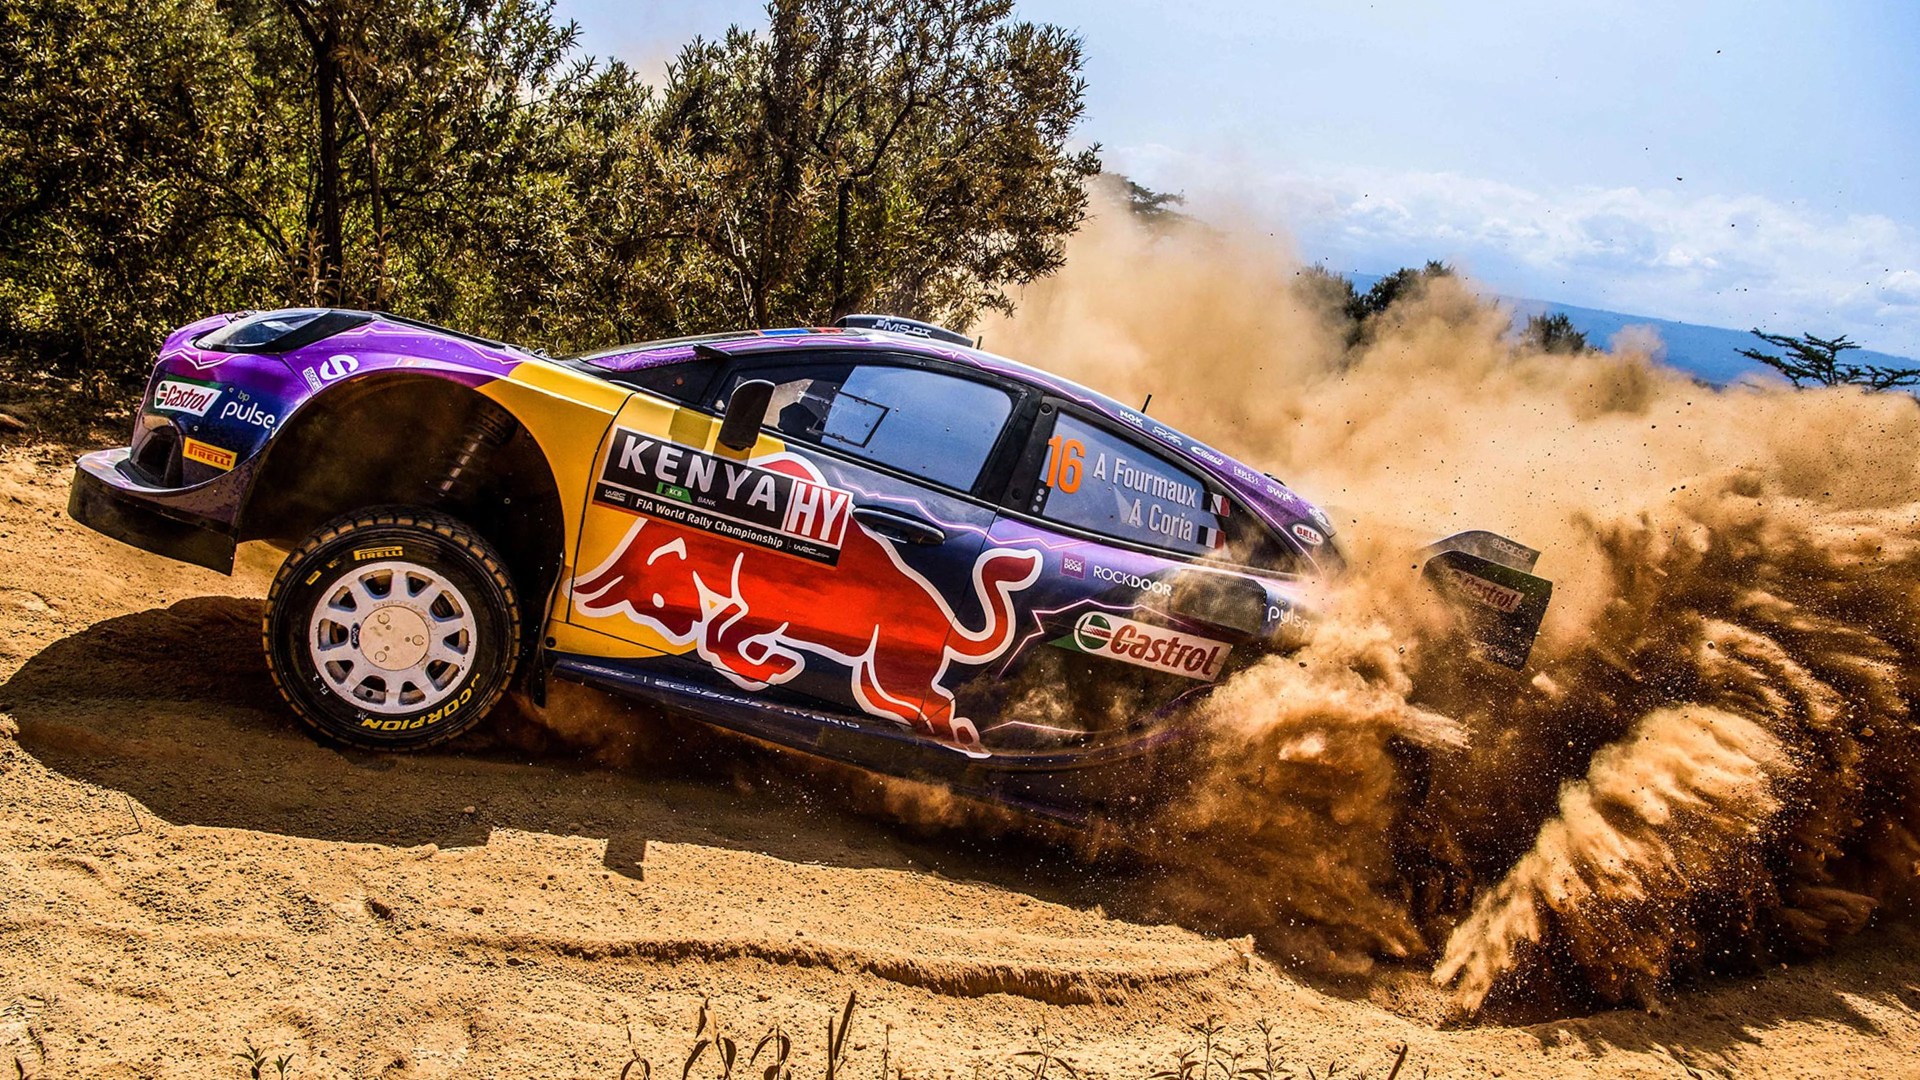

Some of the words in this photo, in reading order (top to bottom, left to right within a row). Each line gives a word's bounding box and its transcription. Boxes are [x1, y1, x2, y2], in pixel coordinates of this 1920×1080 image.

[164, 385, 214, 412] Castrol
[238, 390, 250, 402] bp
[220, 401, 275, 429] pulse
[187, 442, 233, 466] PIRELLI
[1046, 434, 1086, 494] 16
[618, 434, 776, 512] KENYA
[1093, 453, 1106, 481] A
[1112, 458, 1198, 507] Fourmaux
[697, 496, 717, 506] BANK
[786, 481, 849, 541] HY
[636, 499, 653, 511] FIA
[656, 504, 685, 520] World
[687, 514, 713, 529] Rally
[714, 521, 783, 548] Championship
[1128, 499, 1142, 528] A
[1148, 504, 1193, 541] Coria
[1296, 526, 1320, 542] BELL
[353, 546, 403, 561] PIRELLI
[1064, 557, 1084, 566] ROCK
[1064, 563, 1082, 572] DOOR
[1093, 565, 1172, 596] ROCKDOOR
[1267, 606, 1310, 631] pulse
[1110, 624, 1220, 675] Castrol
